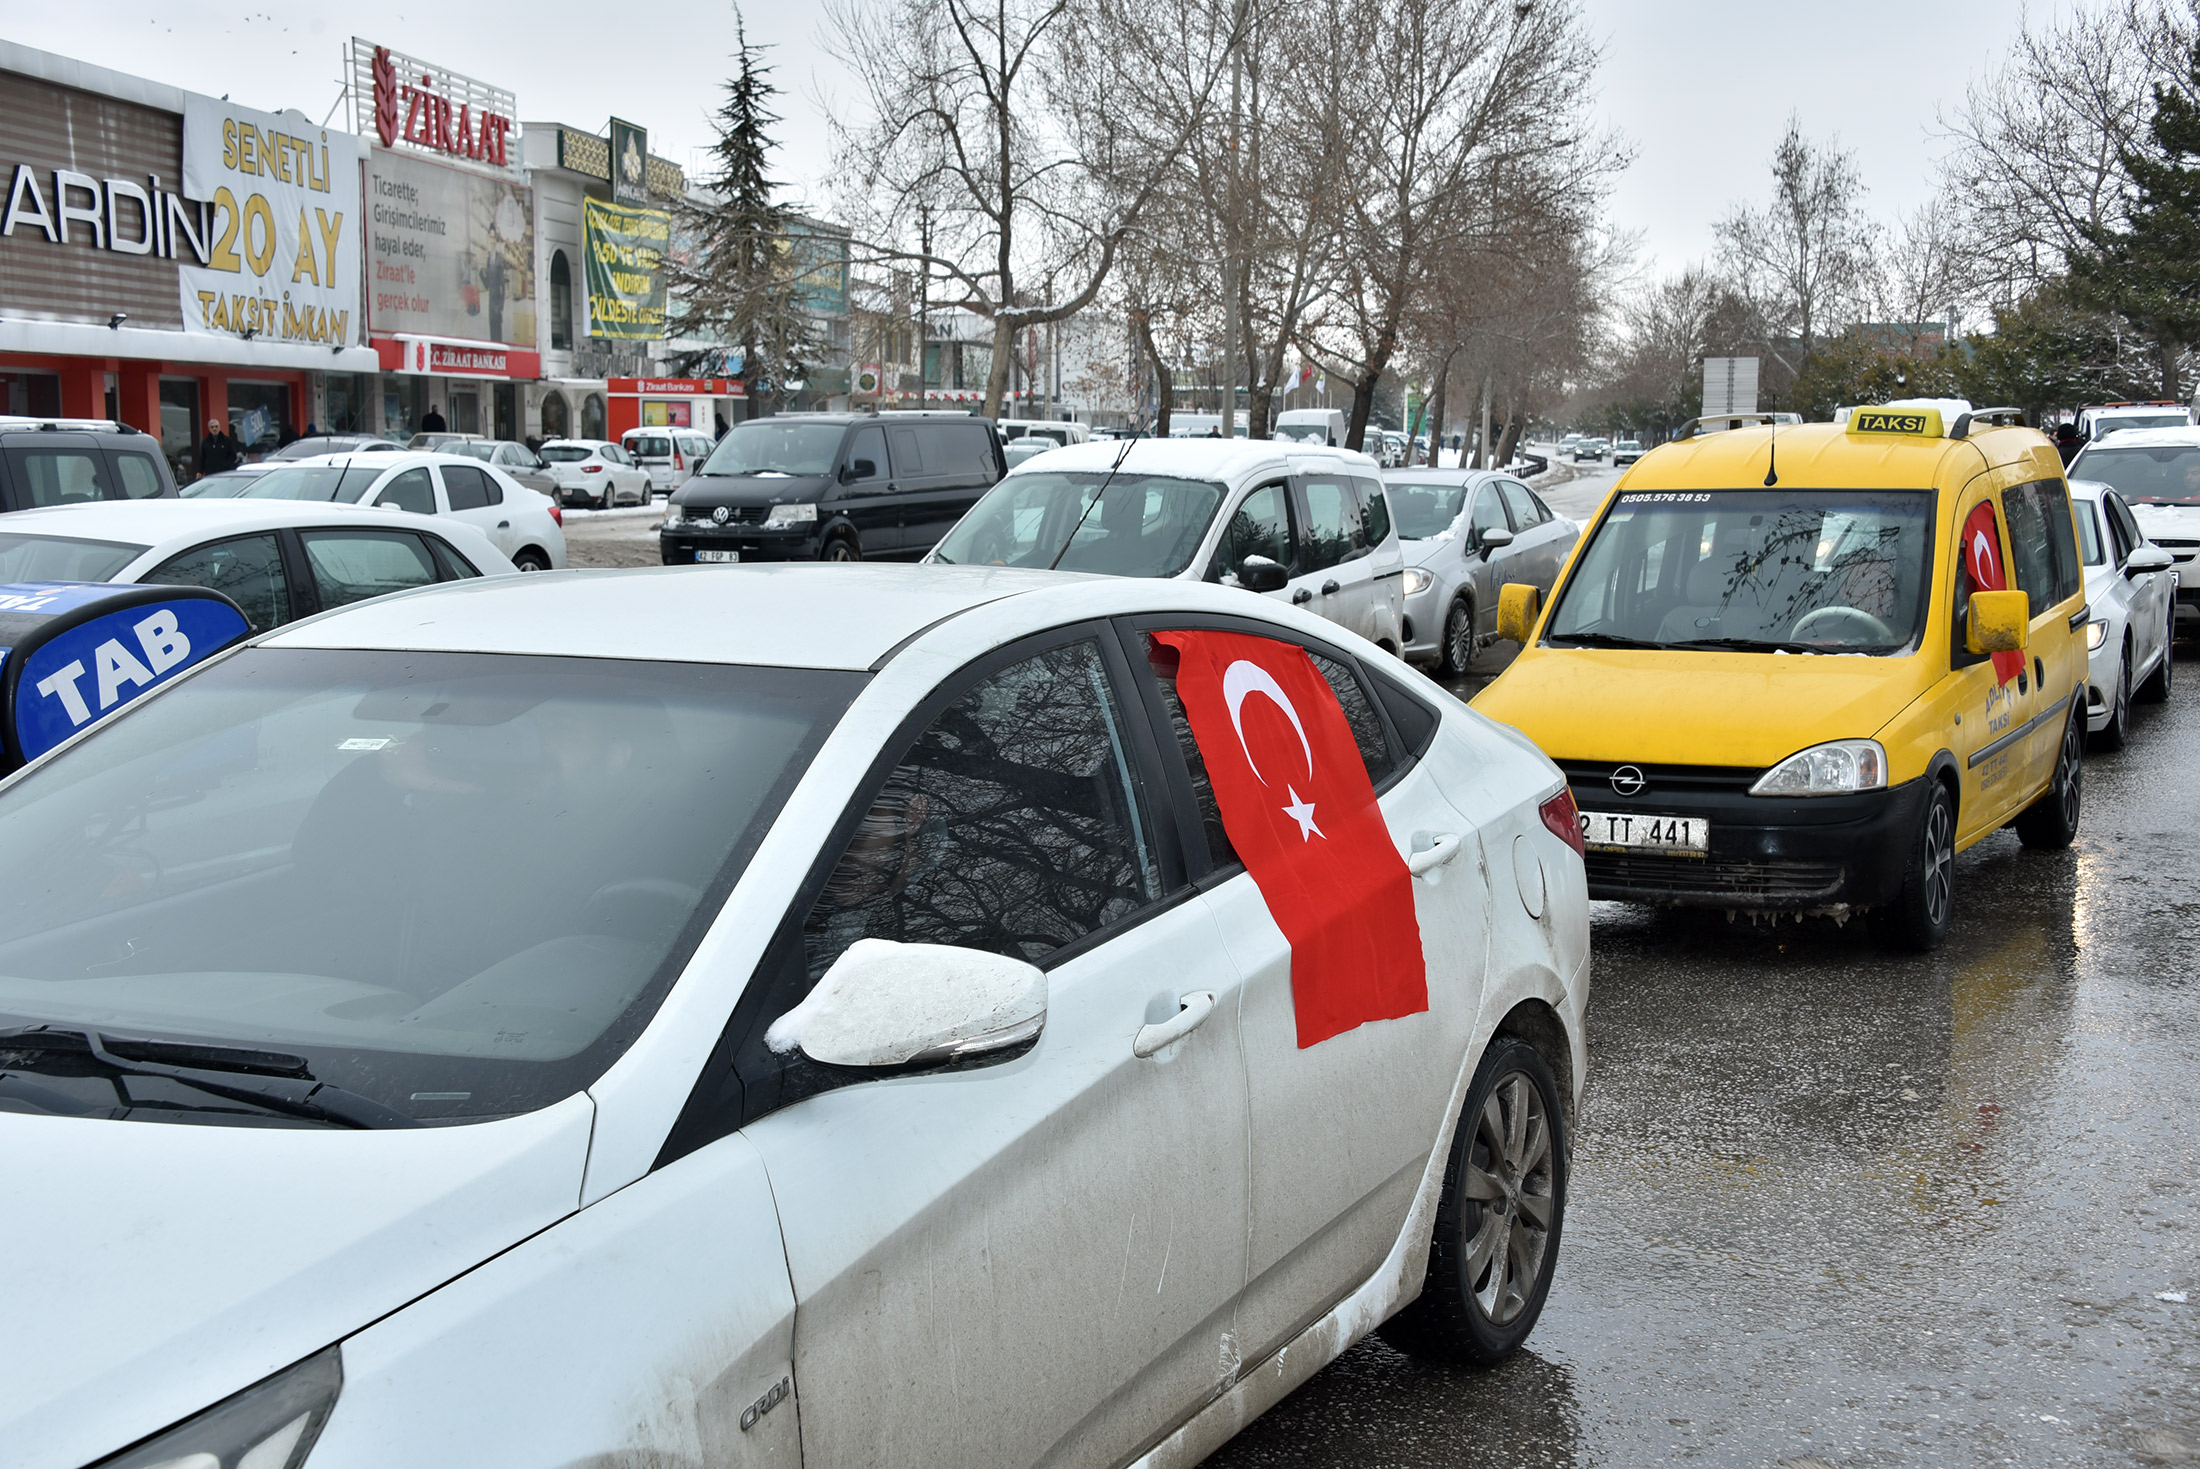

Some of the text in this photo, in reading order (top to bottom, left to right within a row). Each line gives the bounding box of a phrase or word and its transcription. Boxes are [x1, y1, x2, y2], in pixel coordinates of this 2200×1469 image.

[402, 75, 511, 166] ZİRAAT
[223, 117, 331, 194] SENETLİ
[372, 174, 419, 207] Ticarette;
[373, 203, 447, 236] Girişimcilerimiz
[207, 185, 344, 289] 20 AY
[374, 231, 427, 262] hayal eder,
[376, 260, 416, 285] Ziraat'le
[197, 286, 349, 346] TAKSİT İMKANI
[376, 291, 430, 314] gerçek olur
[442, 349, 472, 368] ZİRAAT
[472, 353, 507, 371] BANKASI
[646, 382, 667, 392] Ziraat
[1677, 493, 1694, 502] 38
[1694, 493, 1711, 502] 53
[36, 609, 191, 727] TAB
[1606, 816, 1633, 843] TT
[1649, 819, 1690, 847] 441
